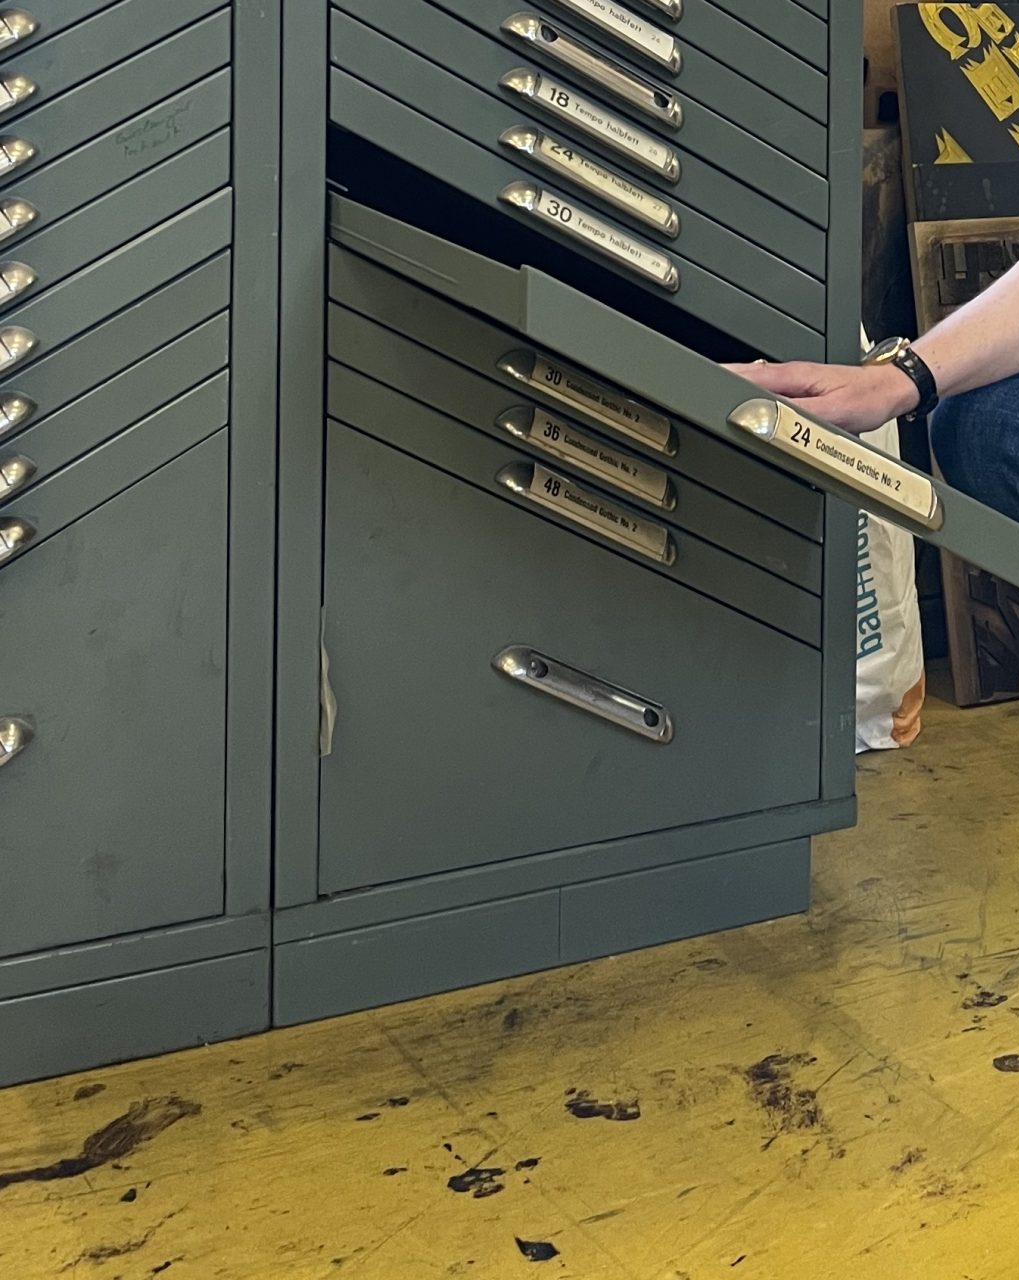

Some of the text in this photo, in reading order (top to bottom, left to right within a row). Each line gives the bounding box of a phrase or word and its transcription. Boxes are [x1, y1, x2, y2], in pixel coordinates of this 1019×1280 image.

[609, 9, 642, 32] halbfett
[550, 87, 570, 109] 18
[575, 104, 603, 125] Tempo
[606, 122, 639, 145] halbfett
[550, 140, 573, 161] 24
[580, 159, 608, 179] Tempo
[611, 178, 643, 200] halbfett
[546, 198, 572, 225] 30
[577, 218, 606, 239] Tempo
[609, 236, 642, 257] halbfett
[545, 366, 562, 386] 30
[566, 380, 599, 402] Condensed
[634, 414, 640, 423] 2
[544, 421, 560, 442] 36
[564, 435, 598, 457] Condensed
[599, 453, 618, 468] Gothic
[633, 469, 638, 477] 2
[790, 420, 901, 492] 24 Condensed Gothic No. 2
[544, 476, 561, 498] 48
[564, 491, 597, 512] Condensed
[599, 508, 619, 523] Gothic
[632, 524, 637, 532] 2
